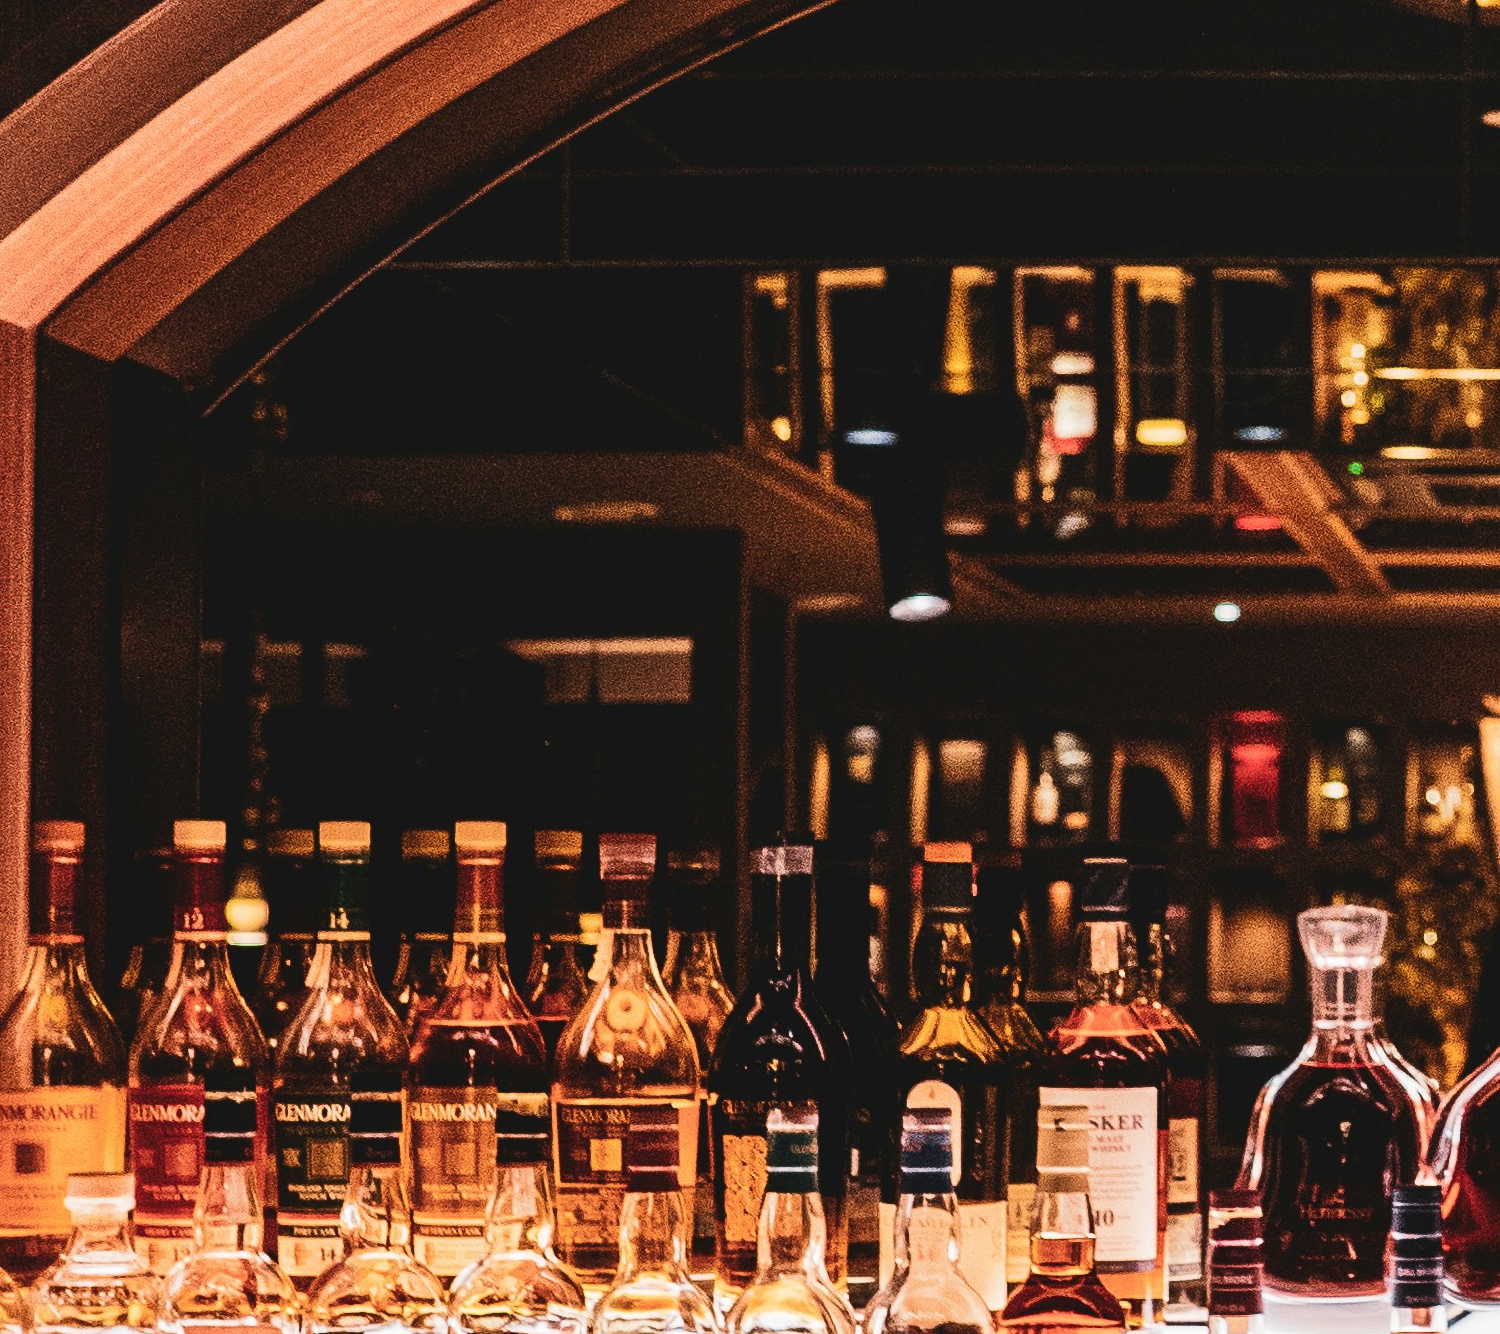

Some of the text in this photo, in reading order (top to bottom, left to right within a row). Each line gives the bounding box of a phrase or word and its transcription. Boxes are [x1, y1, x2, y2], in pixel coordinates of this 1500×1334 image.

[131, 1104, 206, 1122] GLENMORA
[275, 1103, 351, 1122] GLENMORA
[412, 1102, 498, 1122] GLENMORAN
[1091, 1114, 1144, 1132] SKER
